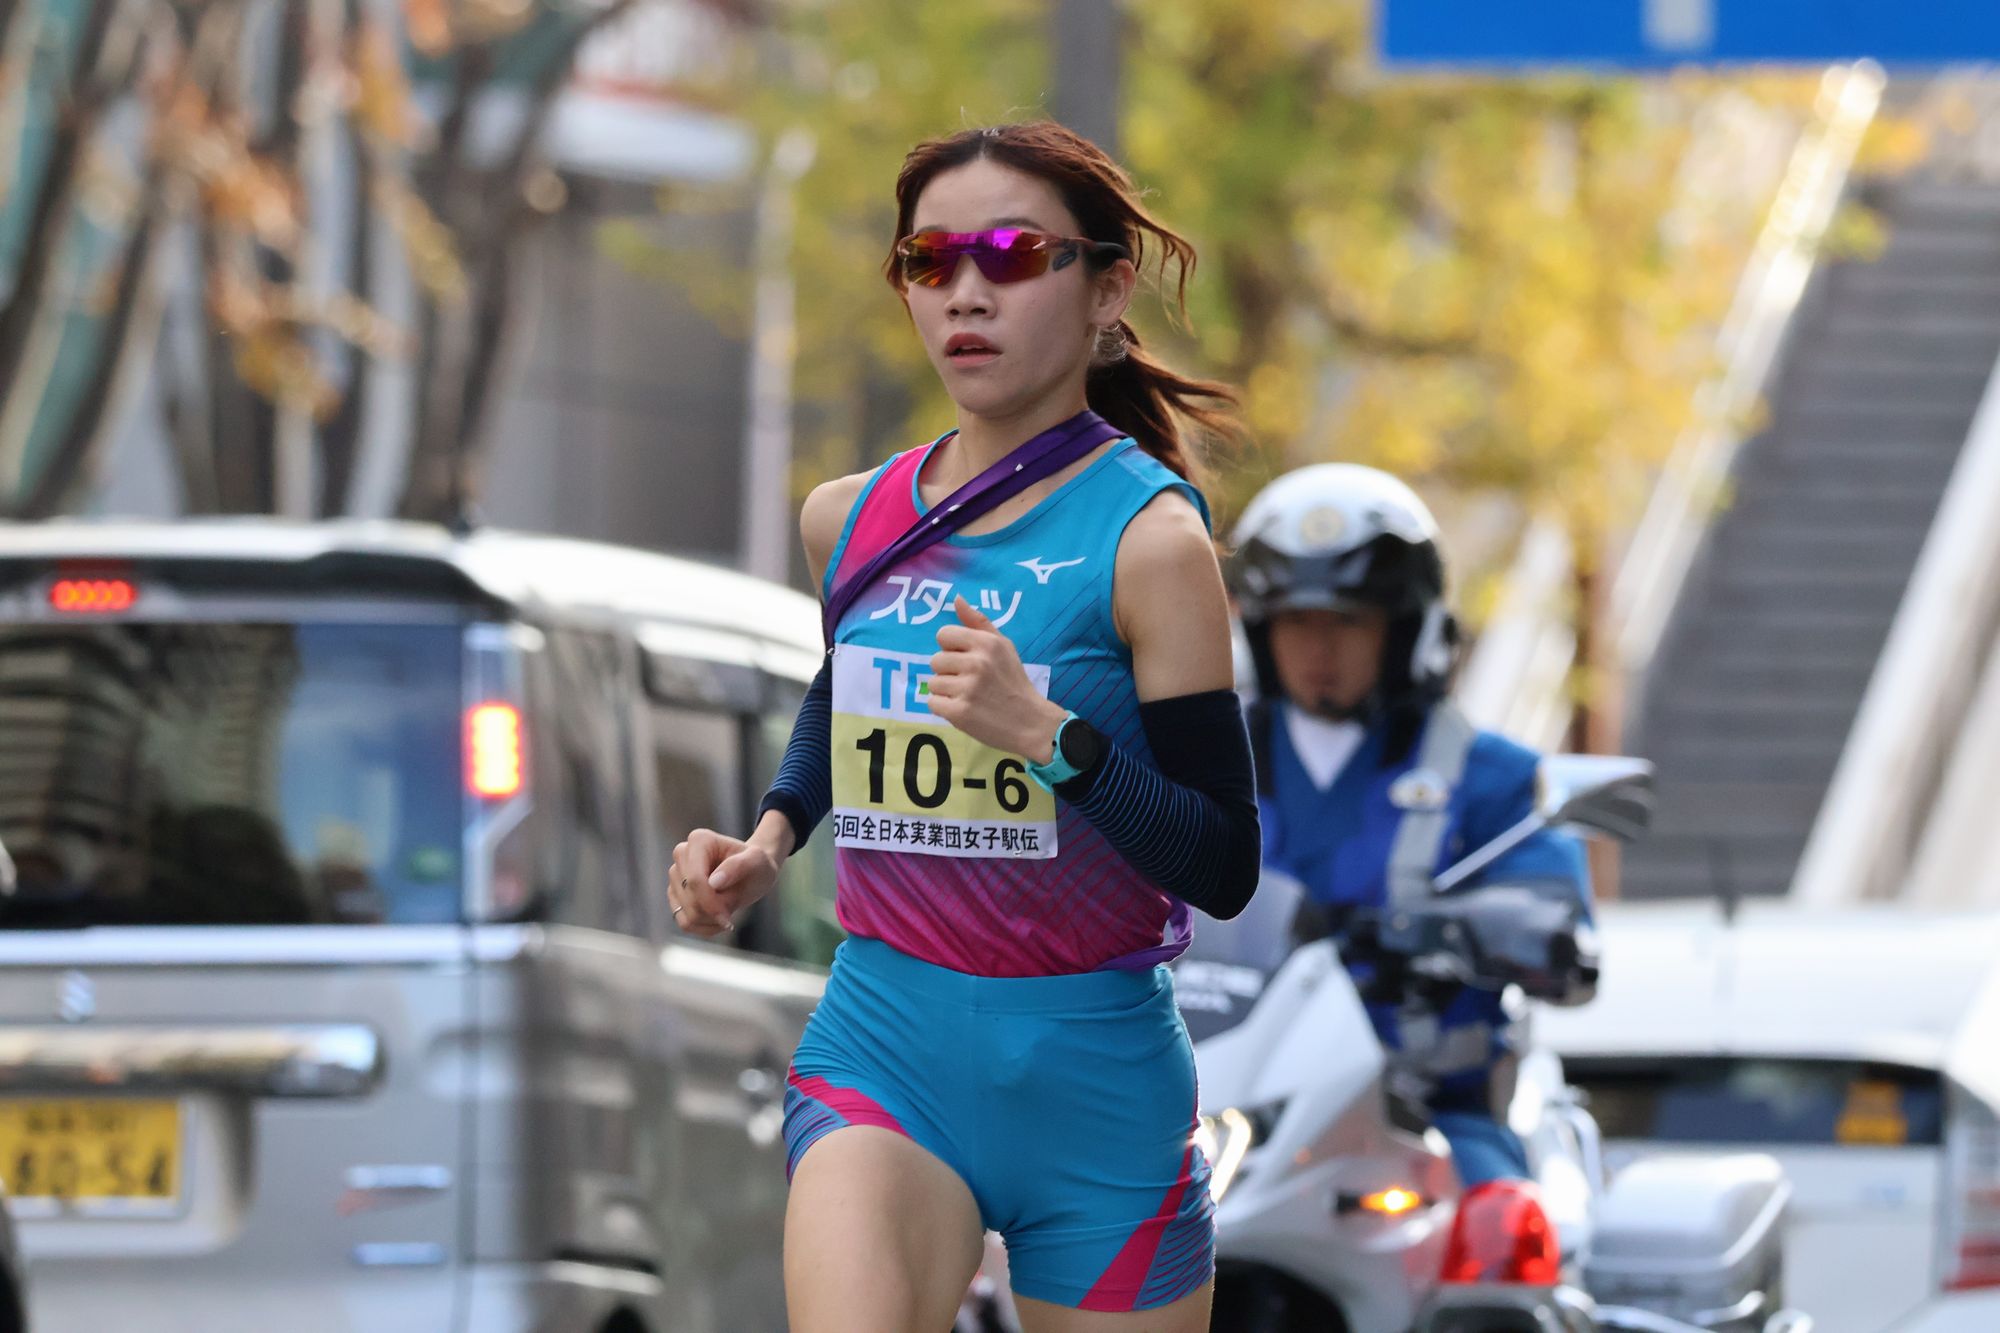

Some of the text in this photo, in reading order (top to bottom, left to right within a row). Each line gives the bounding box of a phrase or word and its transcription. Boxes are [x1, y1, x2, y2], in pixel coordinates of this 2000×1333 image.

[869, 575, 1023, 629] スターツ
[855, 728, 1030, 814] 10-6
